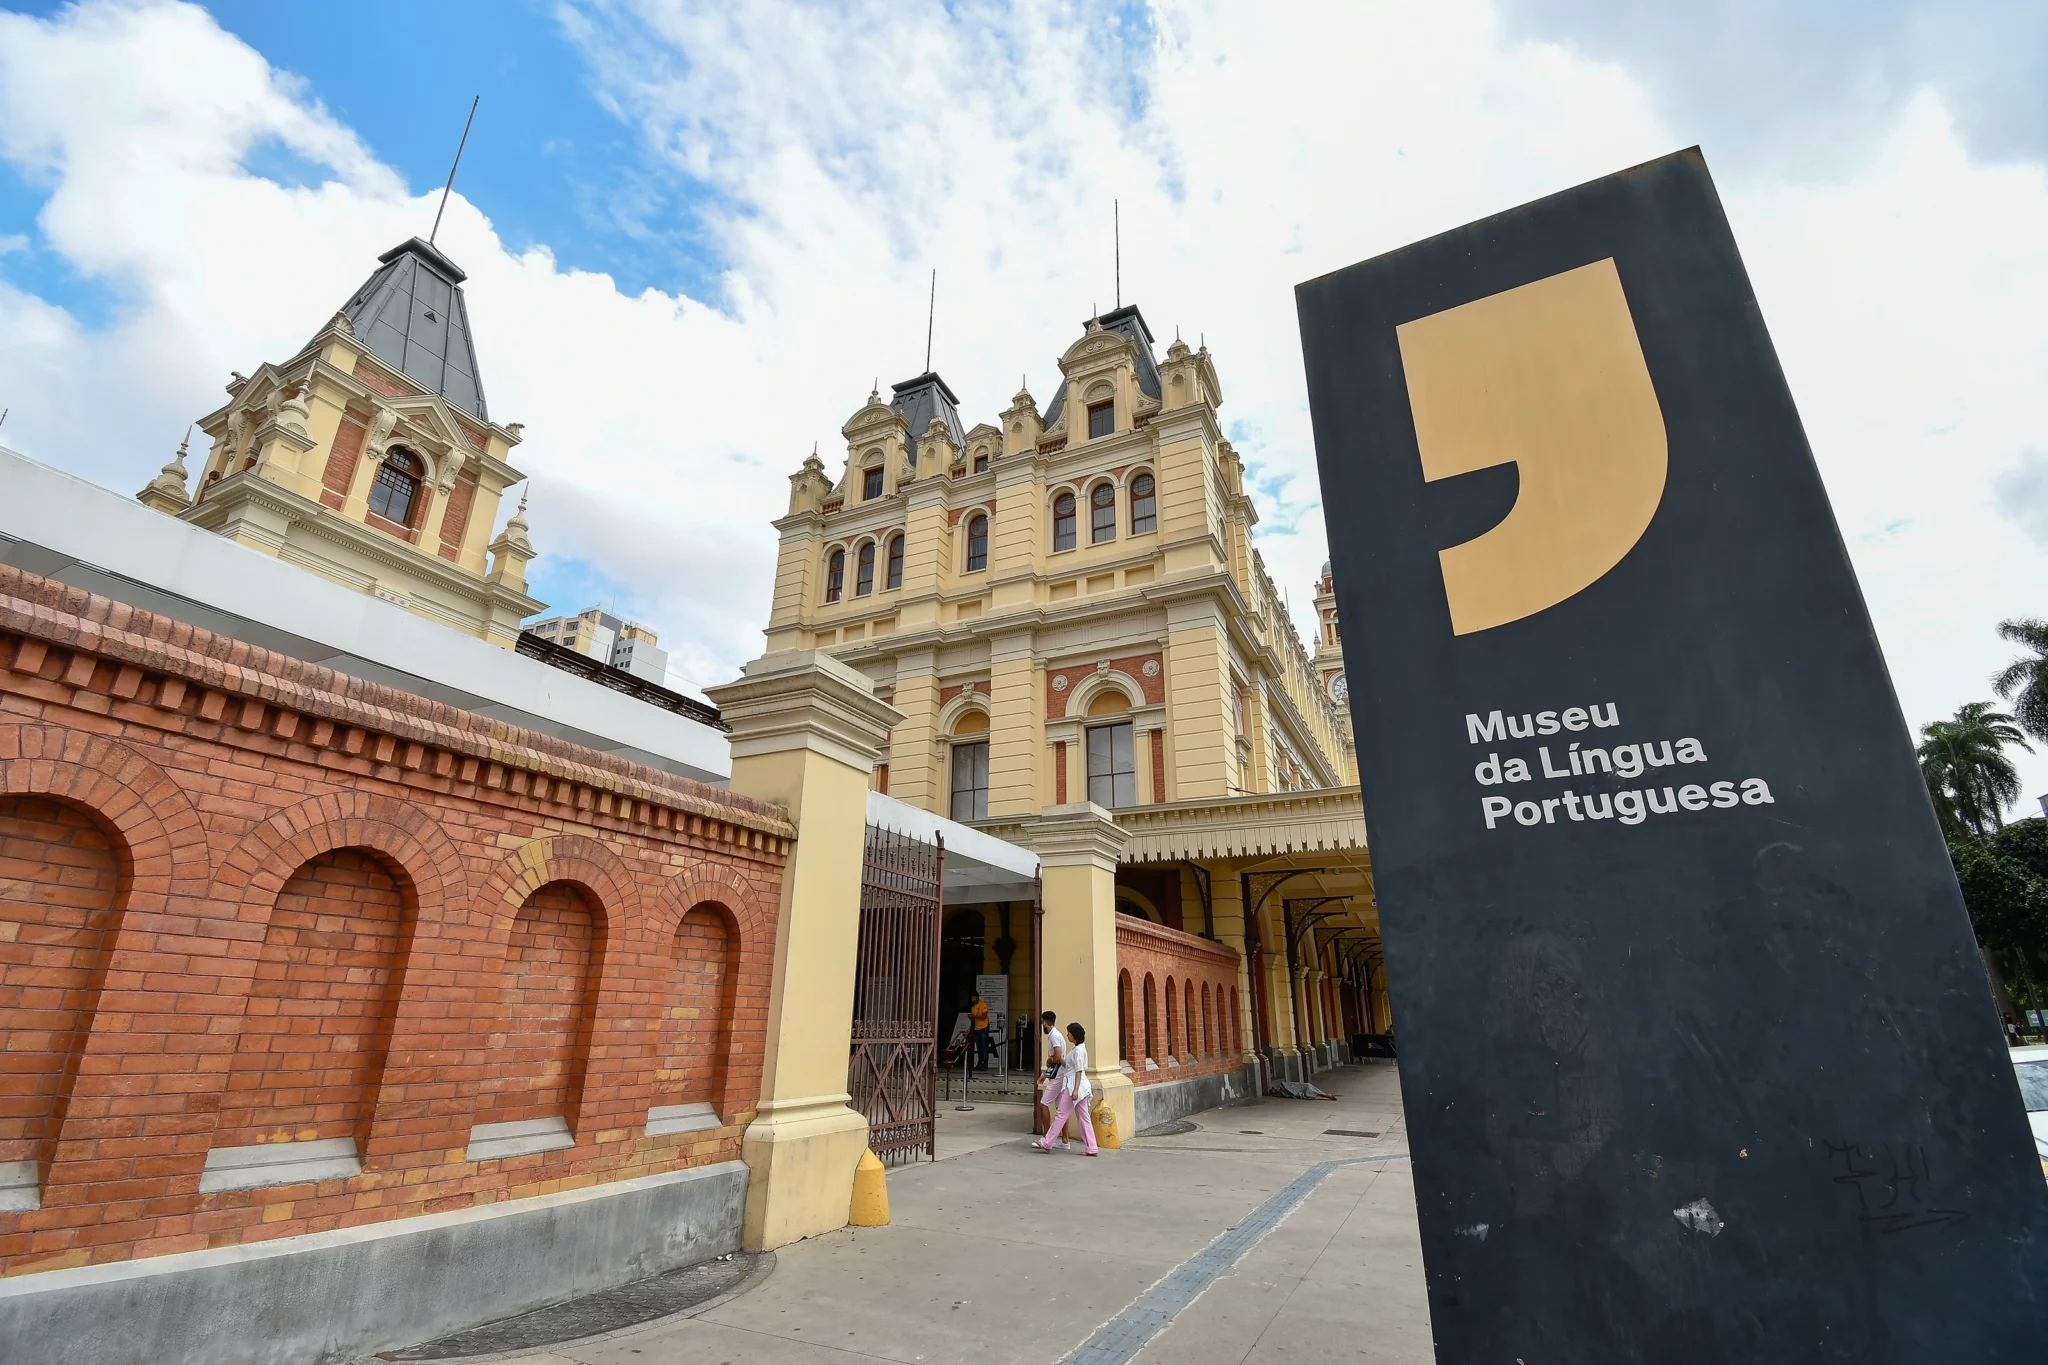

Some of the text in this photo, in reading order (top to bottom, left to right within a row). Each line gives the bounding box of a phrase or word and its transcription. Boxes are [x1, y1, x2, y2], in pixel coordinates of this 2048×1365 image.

[1465, 702, 1620, 744] Museu
[1474, 737, 1708, 786] da Língua
[1481, 777, 1775, 829] Portuguesa
